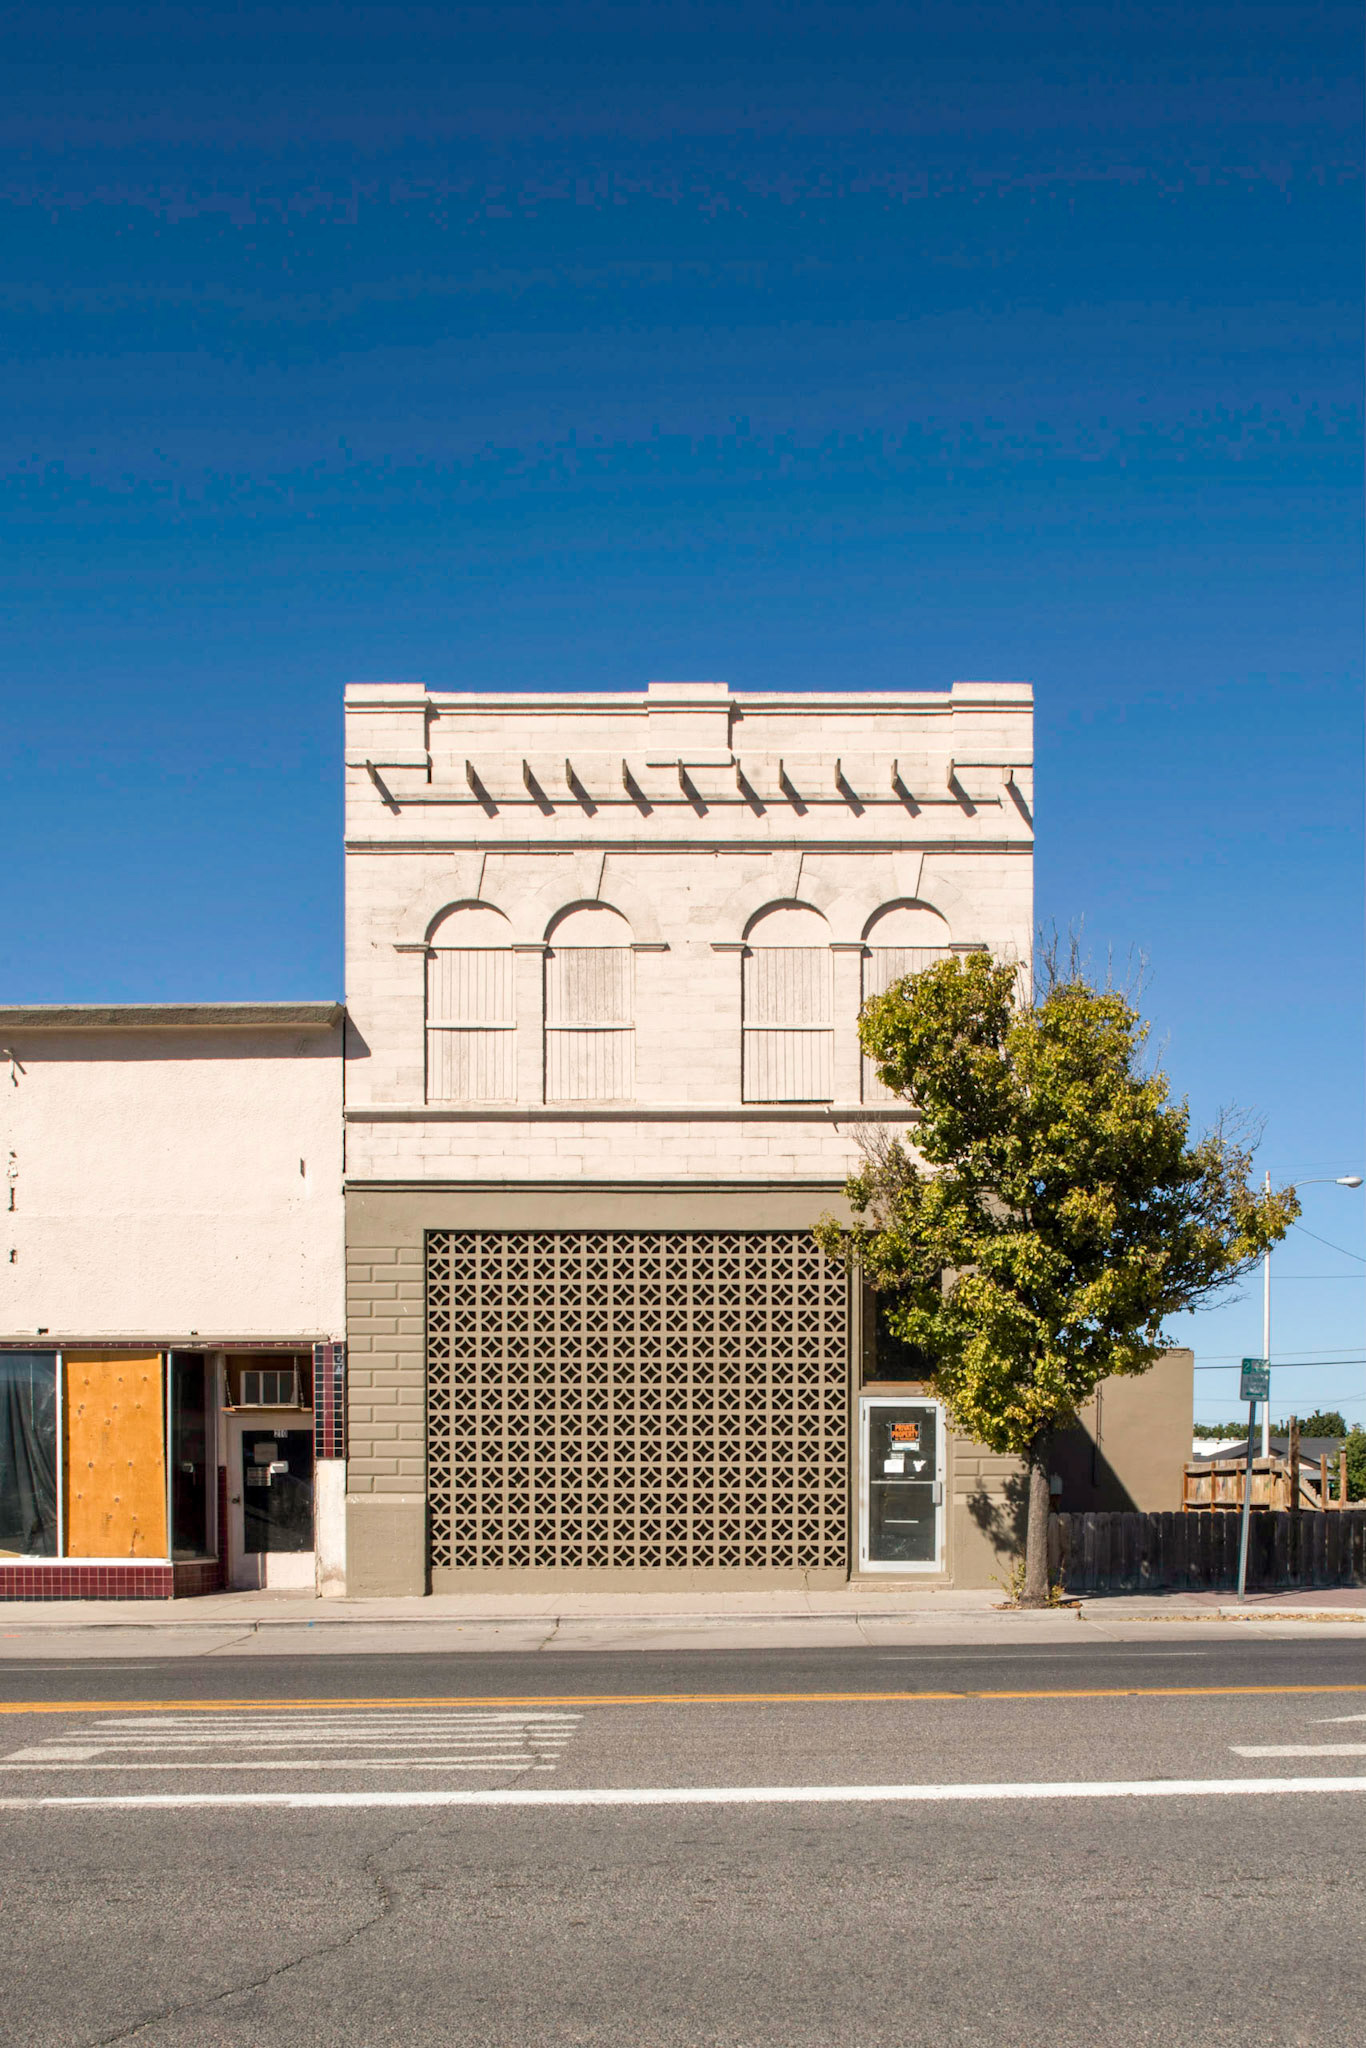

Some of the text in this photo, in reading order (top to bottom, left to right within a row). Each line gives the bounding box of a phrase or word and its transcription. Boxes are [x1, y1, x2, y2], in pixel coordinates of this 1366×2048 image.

[895, 1423, 916, 1431] PRIVATE
[891, 1431, 919, 1439] PROPERTY
[0, 1712, 585, 1770] ONLY
